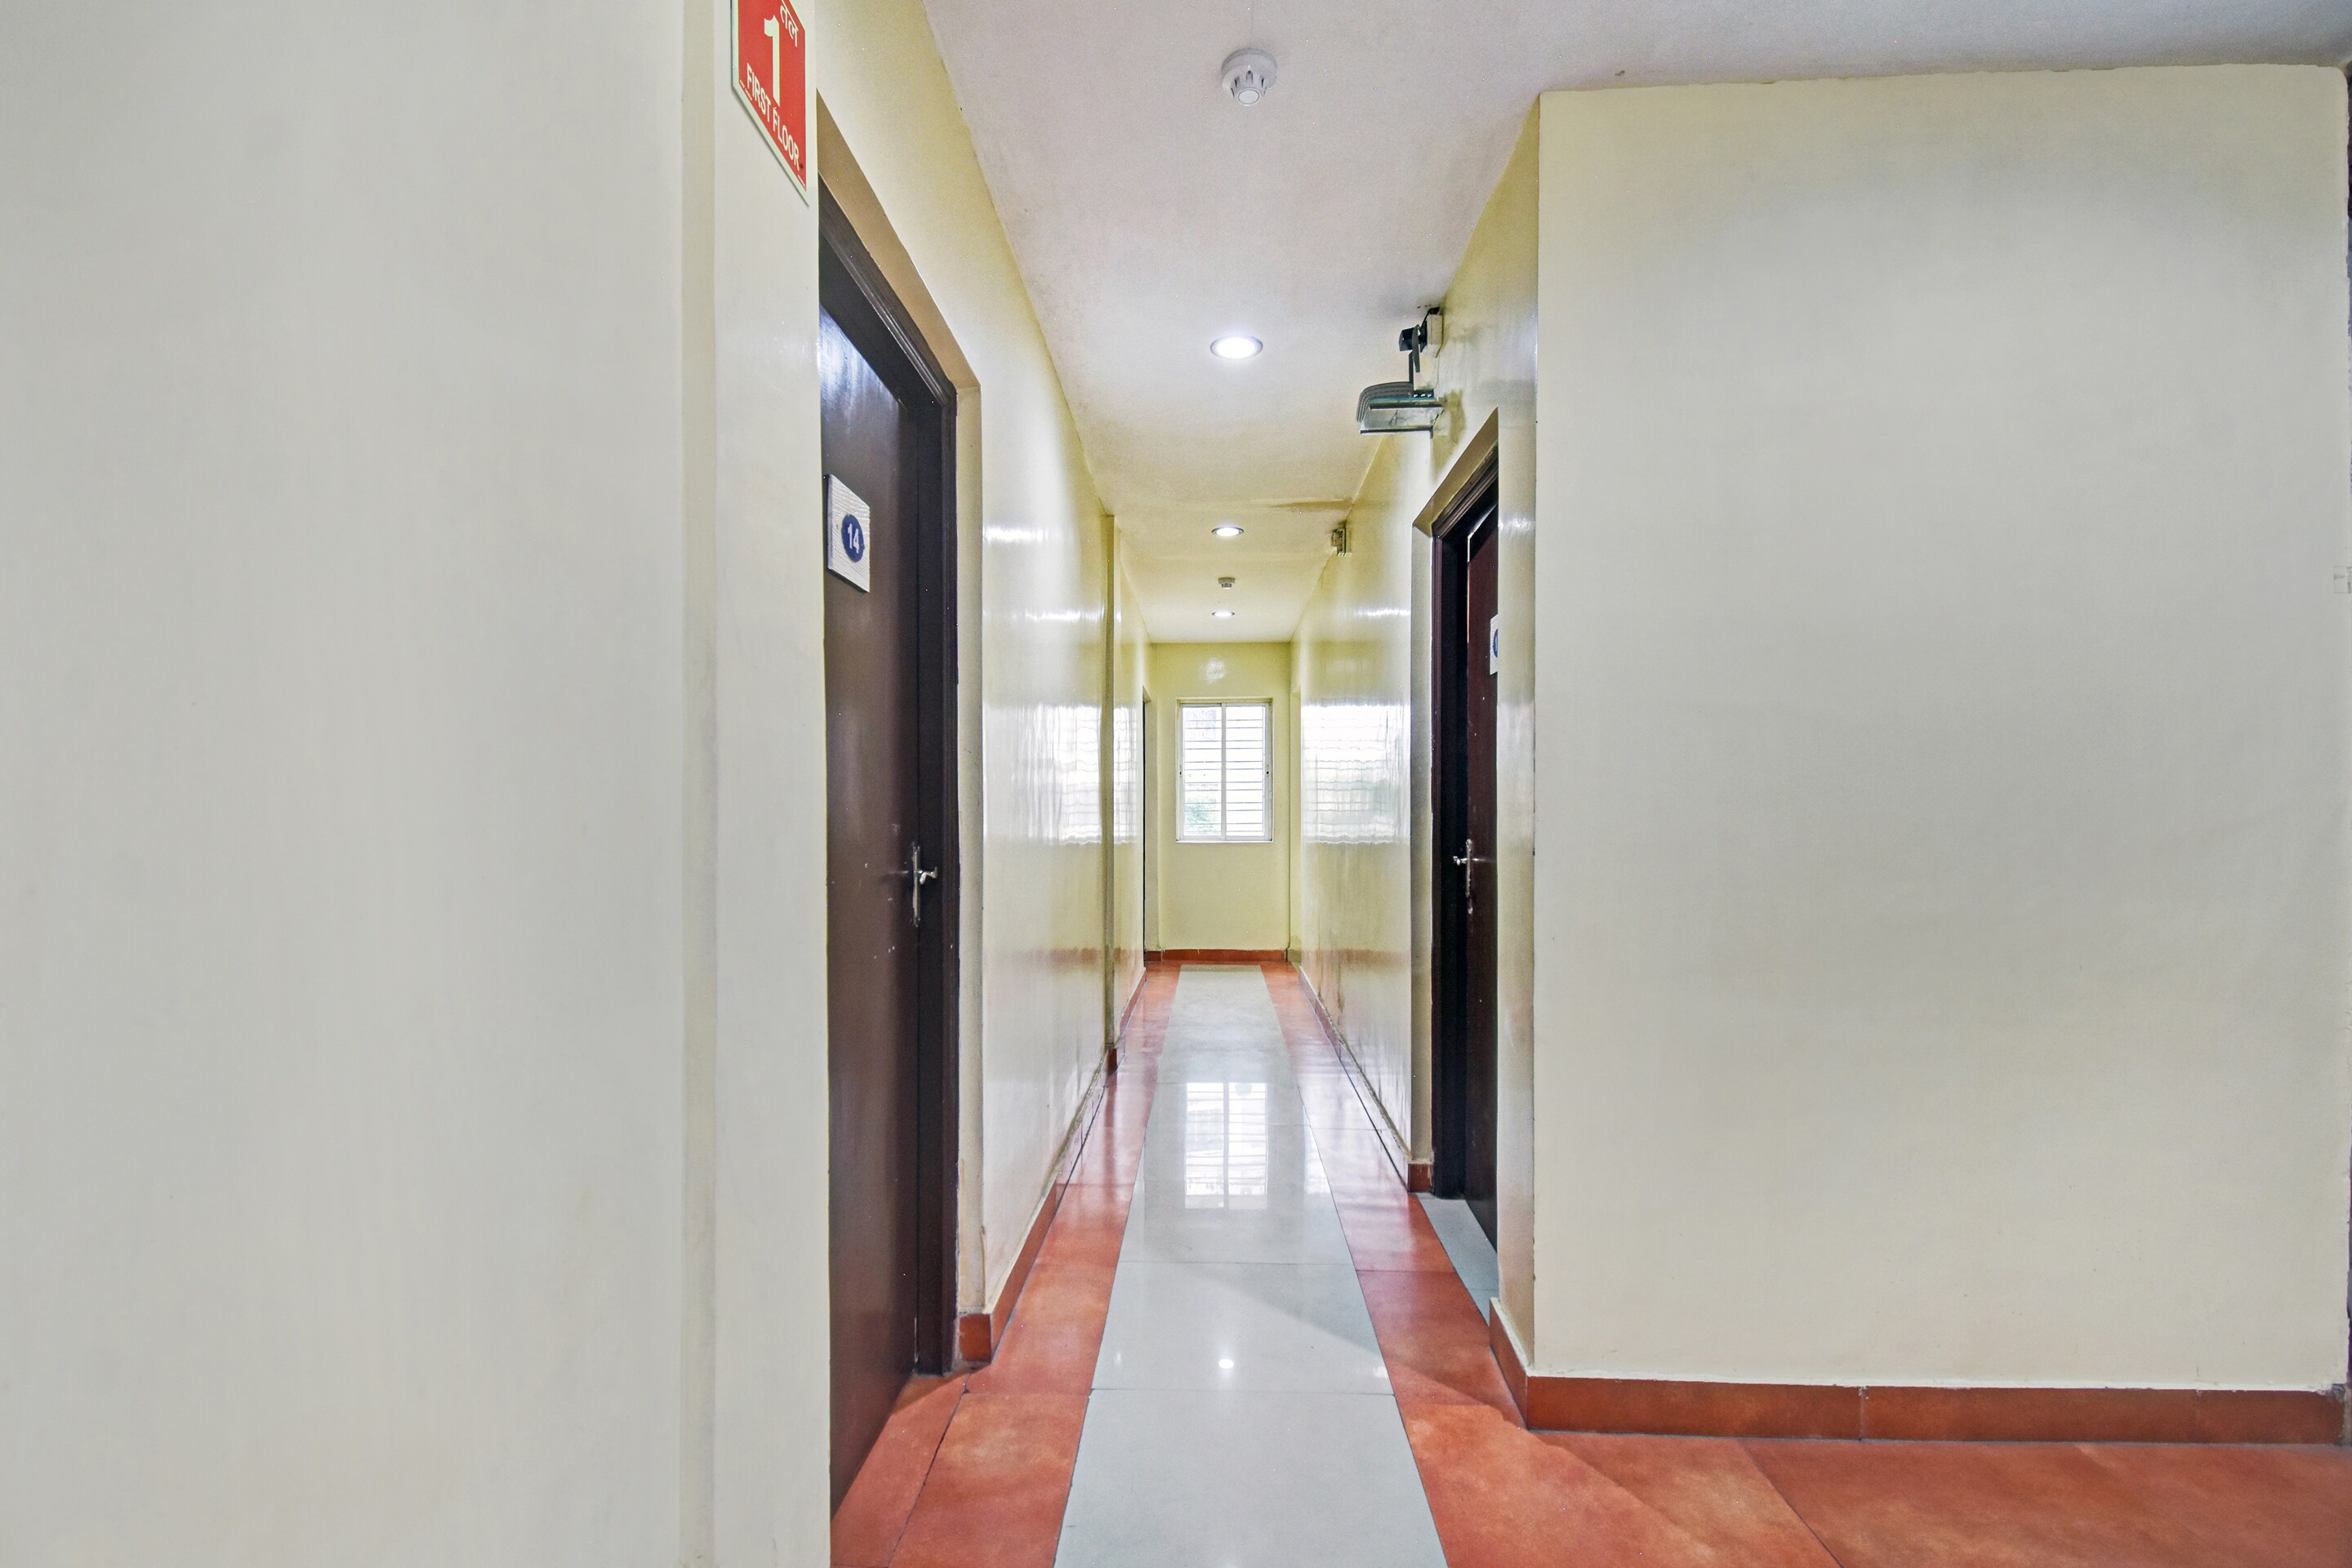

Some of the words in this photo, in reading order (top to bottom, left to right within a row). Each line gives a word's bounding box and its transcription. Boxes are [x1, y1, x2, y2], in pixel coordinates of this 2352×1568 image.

[764, 15, 780, 107] 1
[746, 62, 771, 122] FIRST
[773, 106, 800, 171] FLOOR
[847, 523, 860, 555] 14
